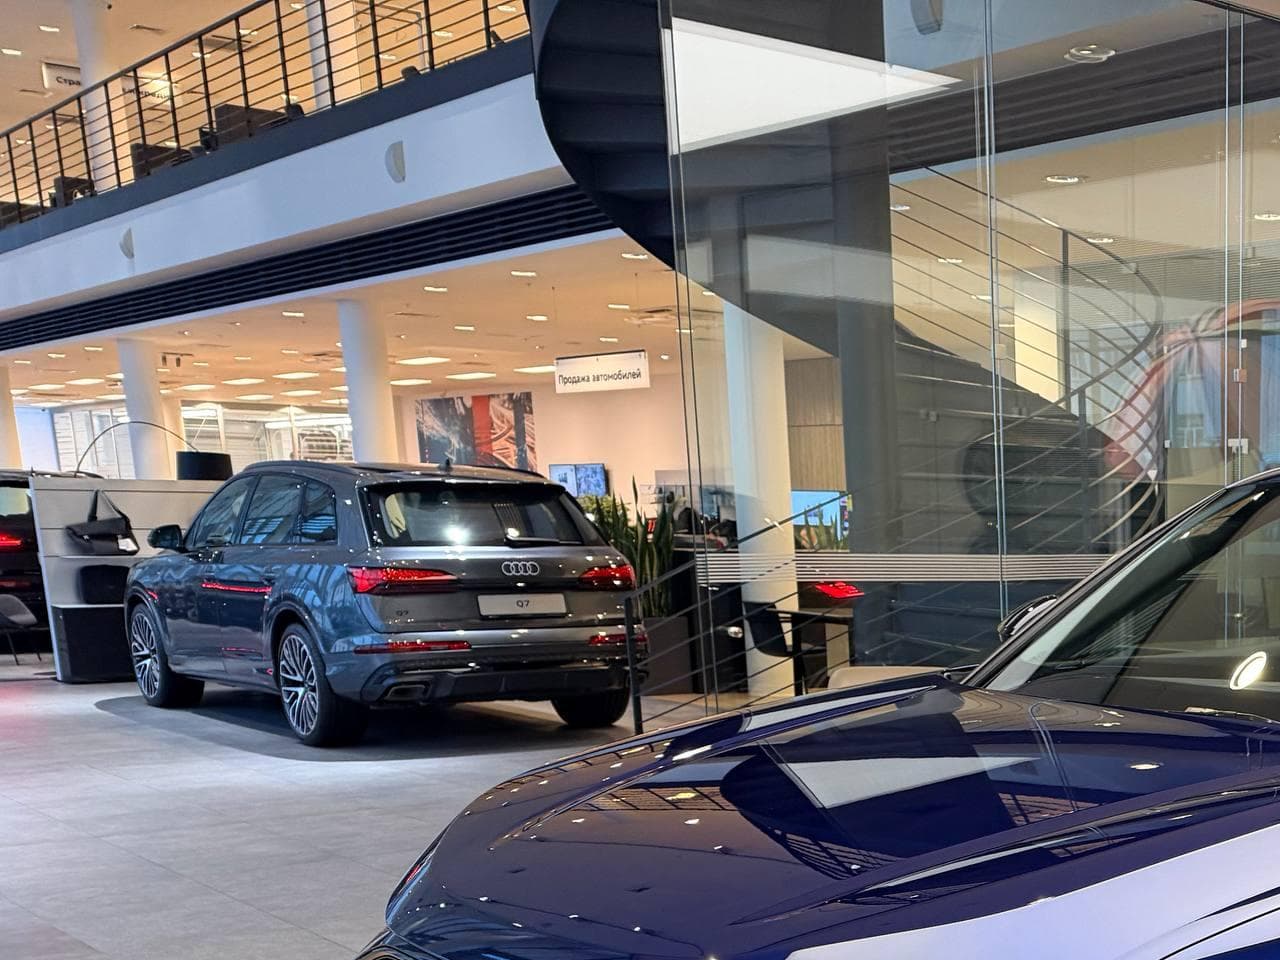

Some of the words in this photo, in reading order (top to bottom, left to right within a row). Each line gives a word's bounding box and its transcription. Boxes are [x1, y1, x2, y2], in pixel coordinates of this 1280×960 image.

[558, 374, 590, 386] Продажа
[592, 368, 642, 382] автомобилей
[516, 600, 530, 609] Q7
